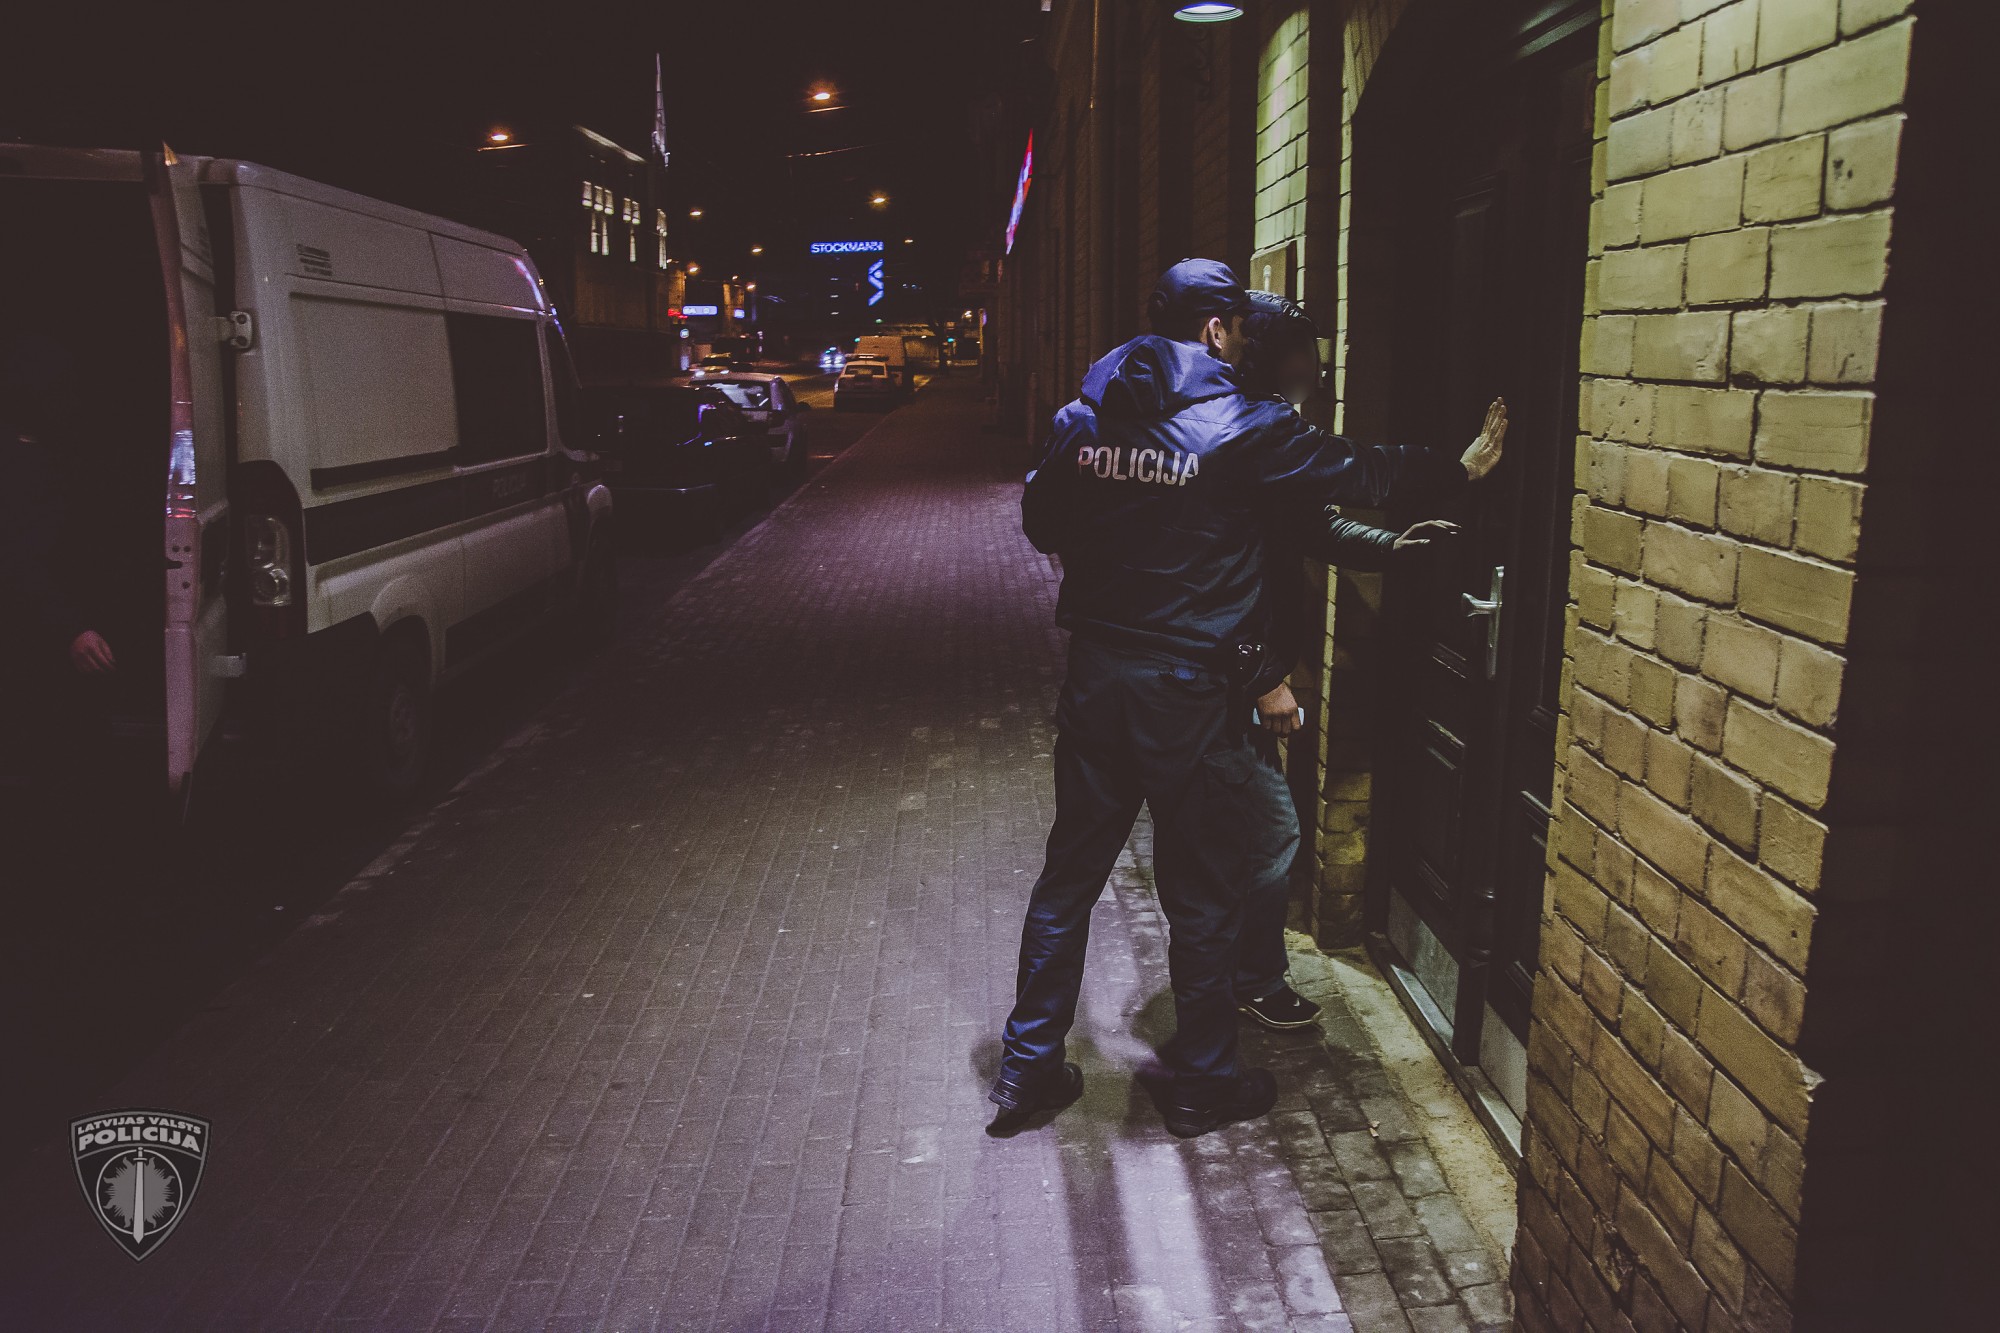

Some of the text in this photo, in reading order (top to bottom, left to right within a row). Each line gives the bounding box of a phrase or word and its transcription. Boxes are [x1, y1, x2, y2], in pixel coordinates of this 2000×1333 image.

[810, 242, 884, 252] STOCKMANN
[1077, 445, 1199, 486] POLICIJA
[492, 471, 528, 498] POLIC
